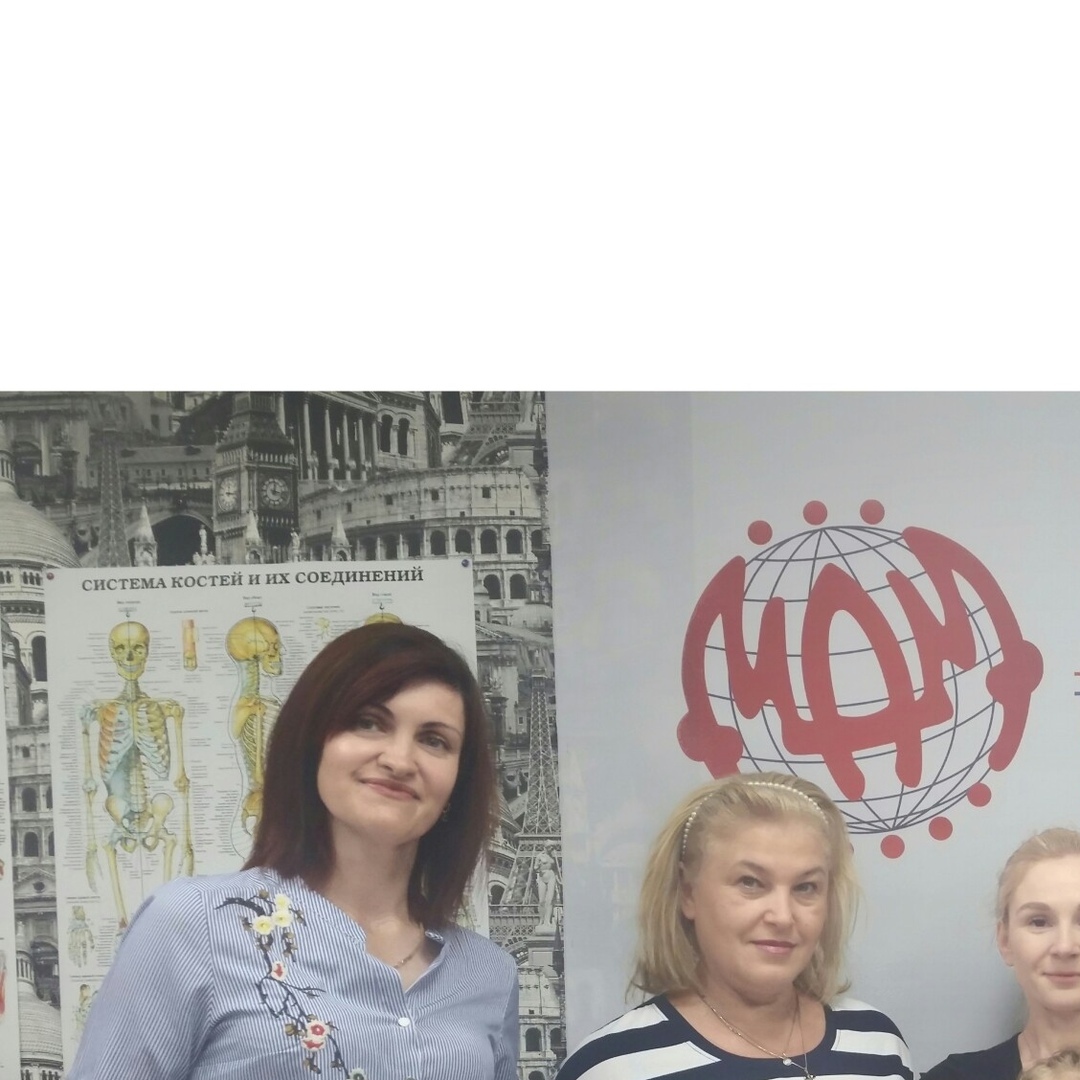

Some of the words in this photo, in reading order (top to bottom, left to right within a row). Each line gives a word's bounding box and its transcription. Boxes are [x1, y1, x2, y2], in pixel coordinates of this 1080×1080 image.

[81, 576, 167, 591] СИСТЕМА
[171, 572, 244, 587] КОСТЕЙ
[249, 575, 260, 585] И
[265, 572, 291, 585] ИХ
[295, 566, 424, 584] СОЕДИНЕНИЙ
